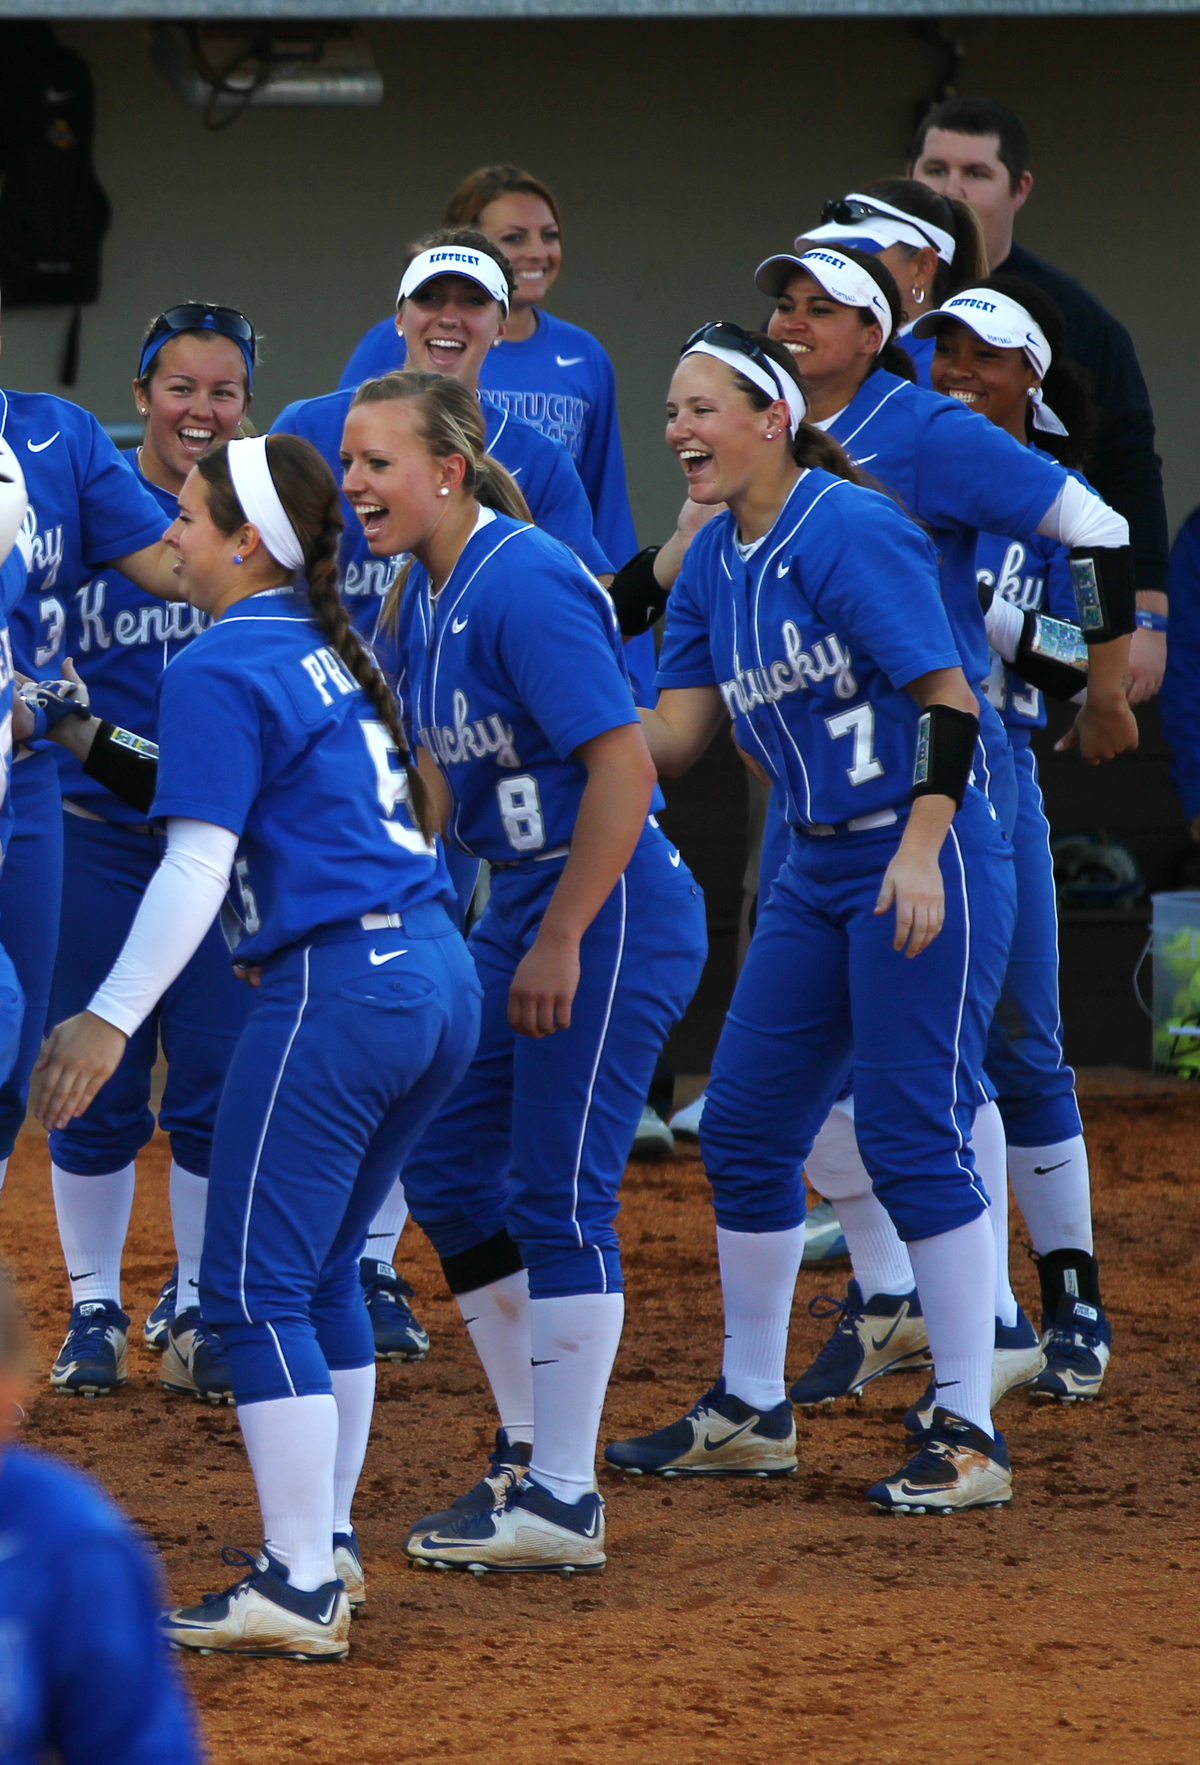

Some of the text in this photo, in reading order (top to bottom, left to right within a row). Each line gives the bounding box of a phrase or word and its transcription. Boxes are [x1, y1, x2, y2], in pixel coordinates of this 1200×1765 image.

[429, 252, 480, 266] KENTUCKY
[824, 701, 885, 787] 7
[497, 774, 546, 852] 8
